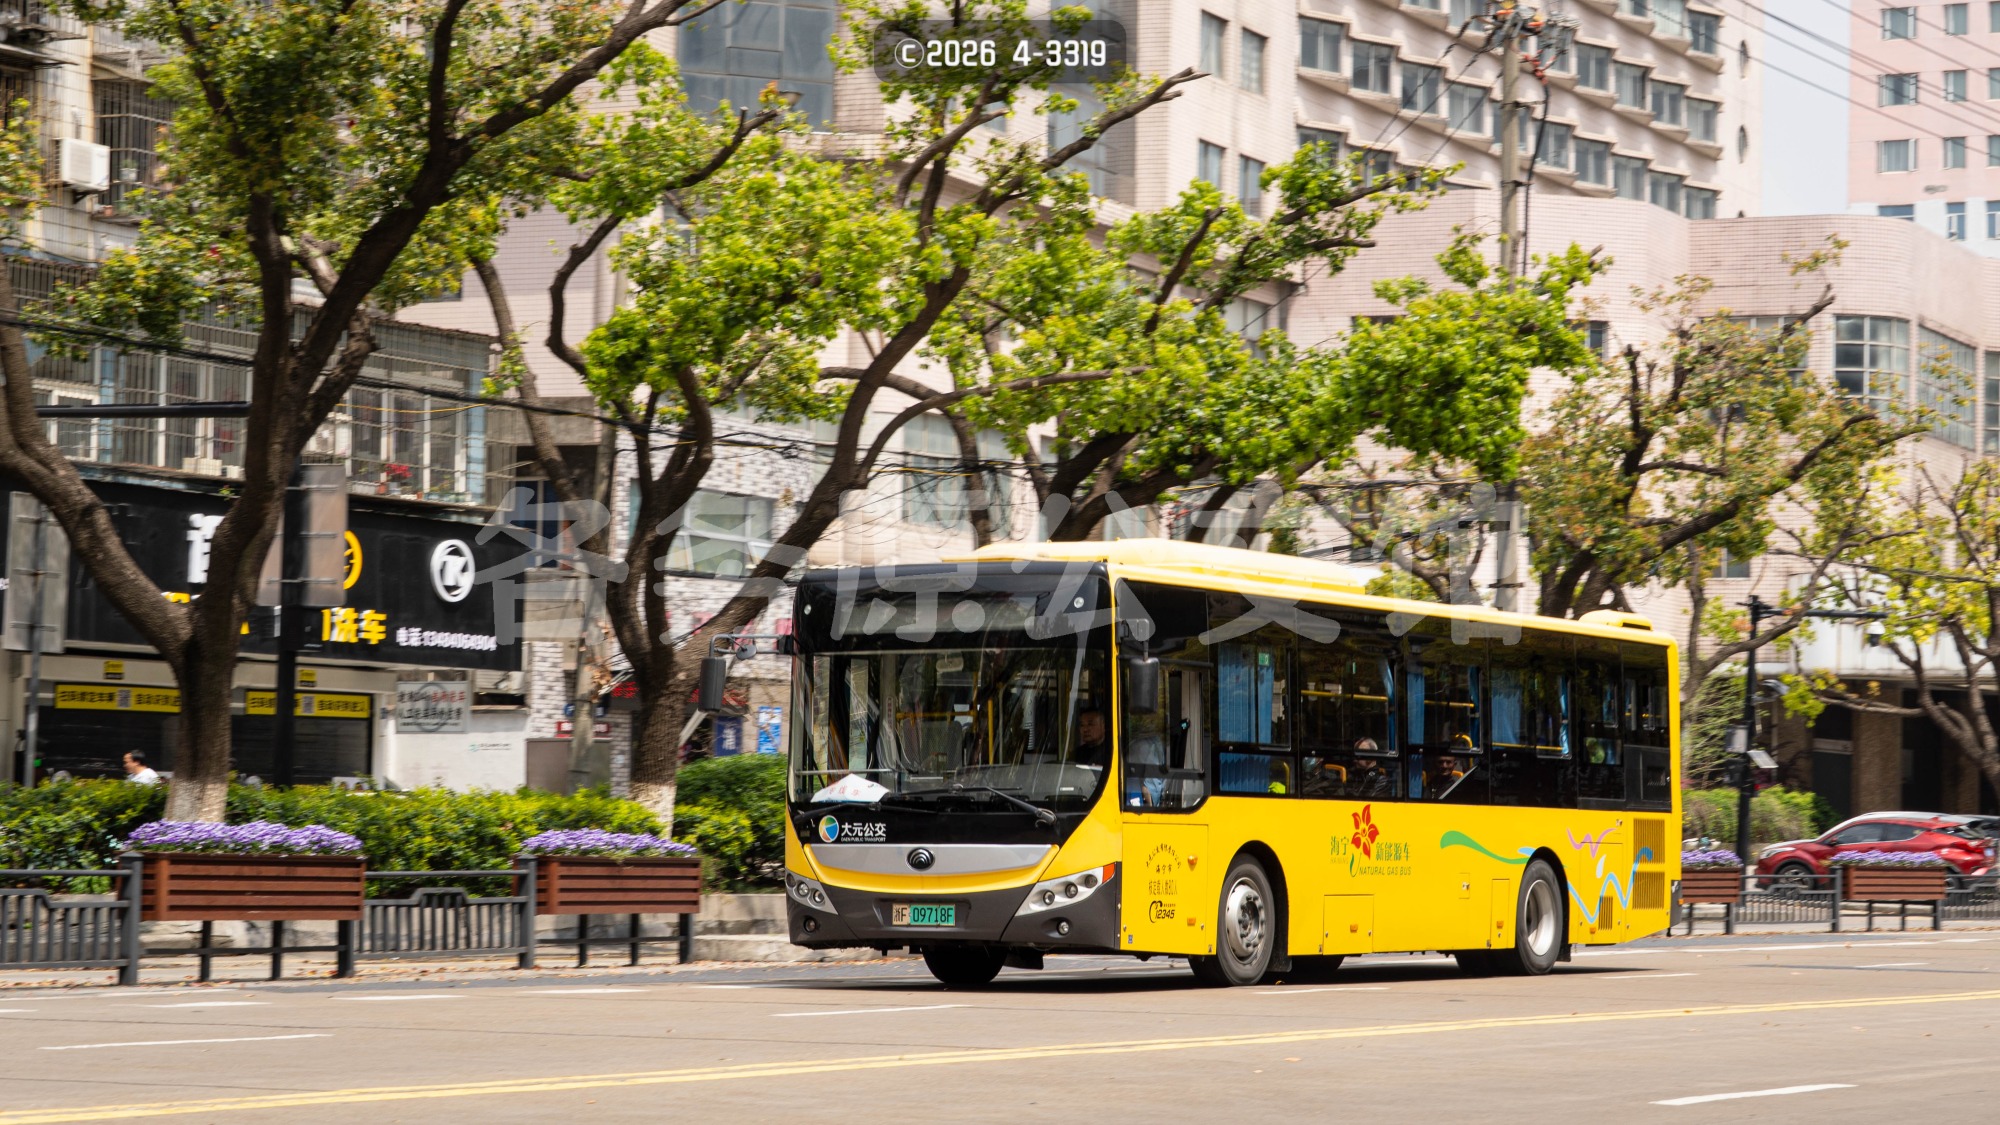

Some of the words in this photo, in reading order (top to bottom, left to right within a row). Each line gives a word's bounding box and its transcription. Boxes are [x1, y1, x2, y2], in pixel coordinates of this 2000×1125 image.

[841, 822, 887, 837] 大元公交
[1330, 836, 1349, 855] 海宁
[1376, 842, 1410, 861] 新能源车
[1359, 866, 1385, 876] NATURAL
[1387, 866, 1399, 876] GAS
[1400, 866, 1412, 876] BUS
[1155, 909, 1176, 919] 12345
